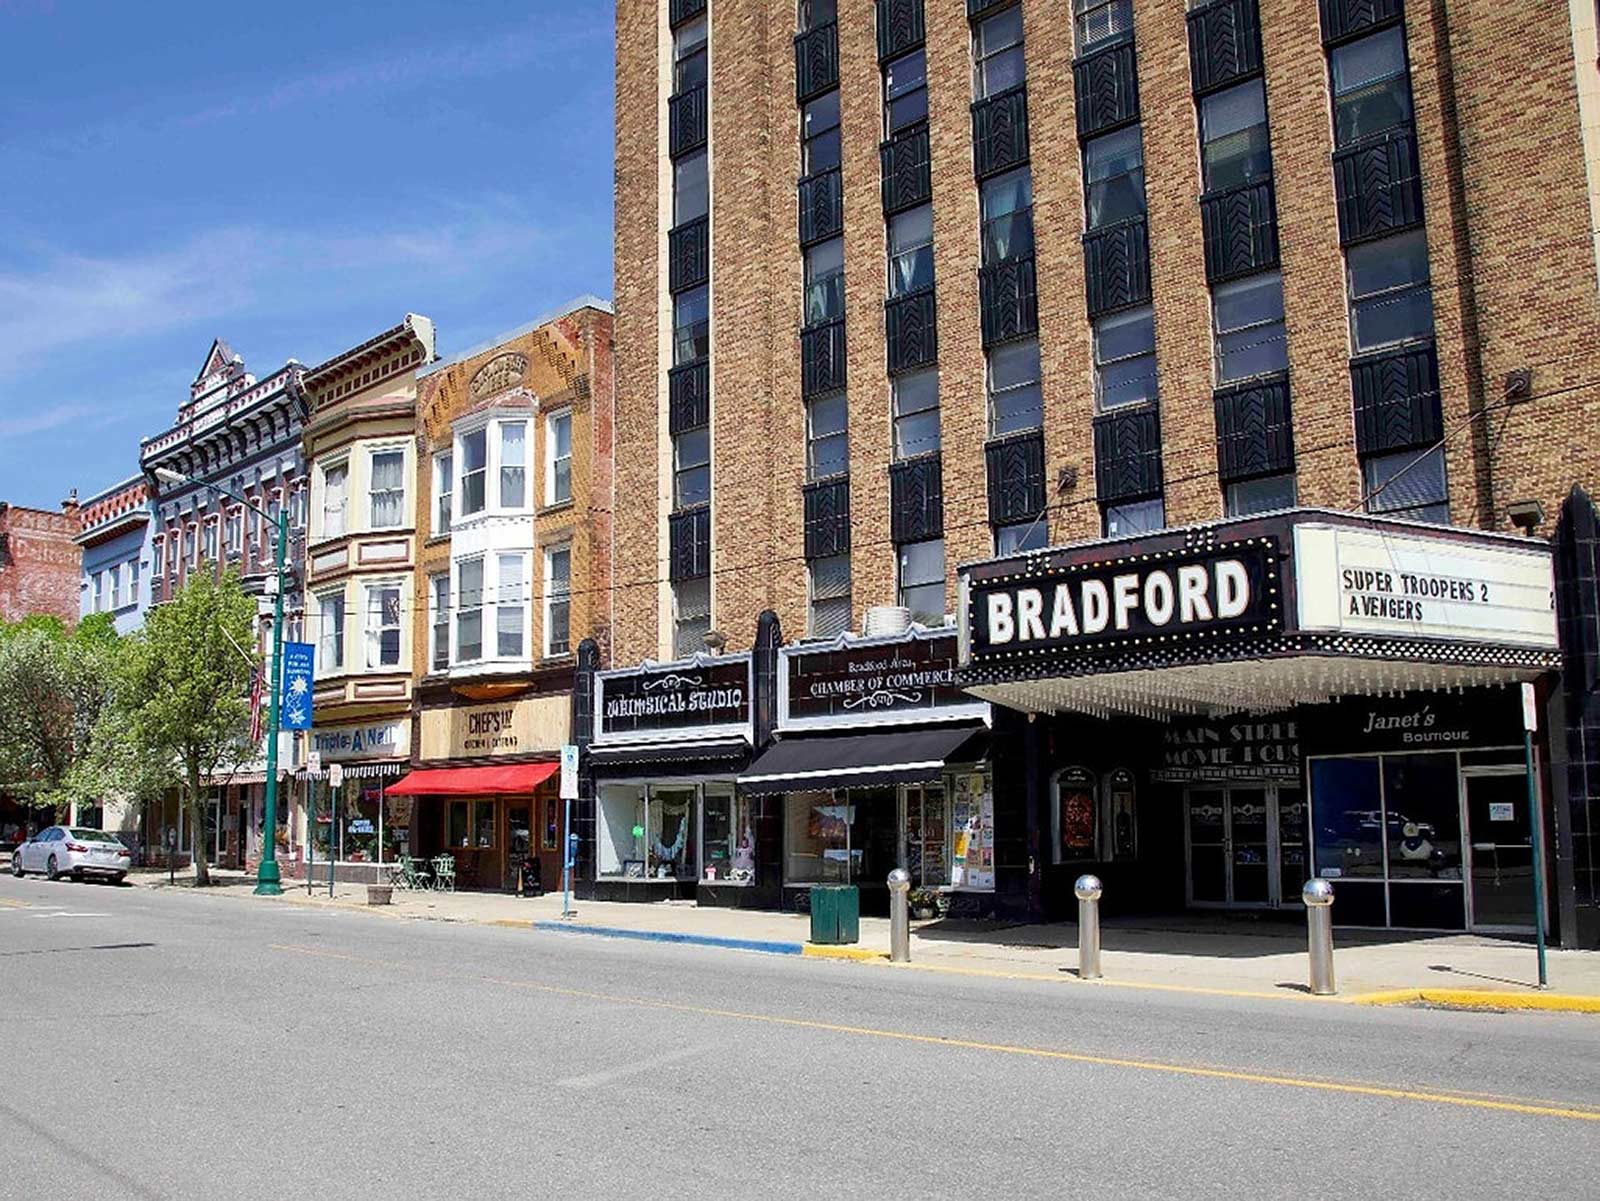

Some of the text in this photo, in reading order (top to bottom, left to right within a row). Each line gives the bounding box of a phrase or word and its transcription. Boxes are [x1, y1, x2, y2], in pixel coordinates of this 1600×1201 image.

[1343, 569, 1489, 602] SUPER TROOPERS 2
[987, 560, 1249, 645] BRADFORD
[1350, 595, 1423, 621] AVENGERS
[810, 670, 955, 696] CHAMBER OF COMMERCE
[607, 689, 742, 718] WHIMSICAL STUDIO
[1363, 705, 1435, 733] Janet's
[1163, 722, 1298, 745] MAIN STREE
[1403, 731, 1470, 743] BOUTIQUE
[1165, 744, 1299, 765] MOVIE HOUS
